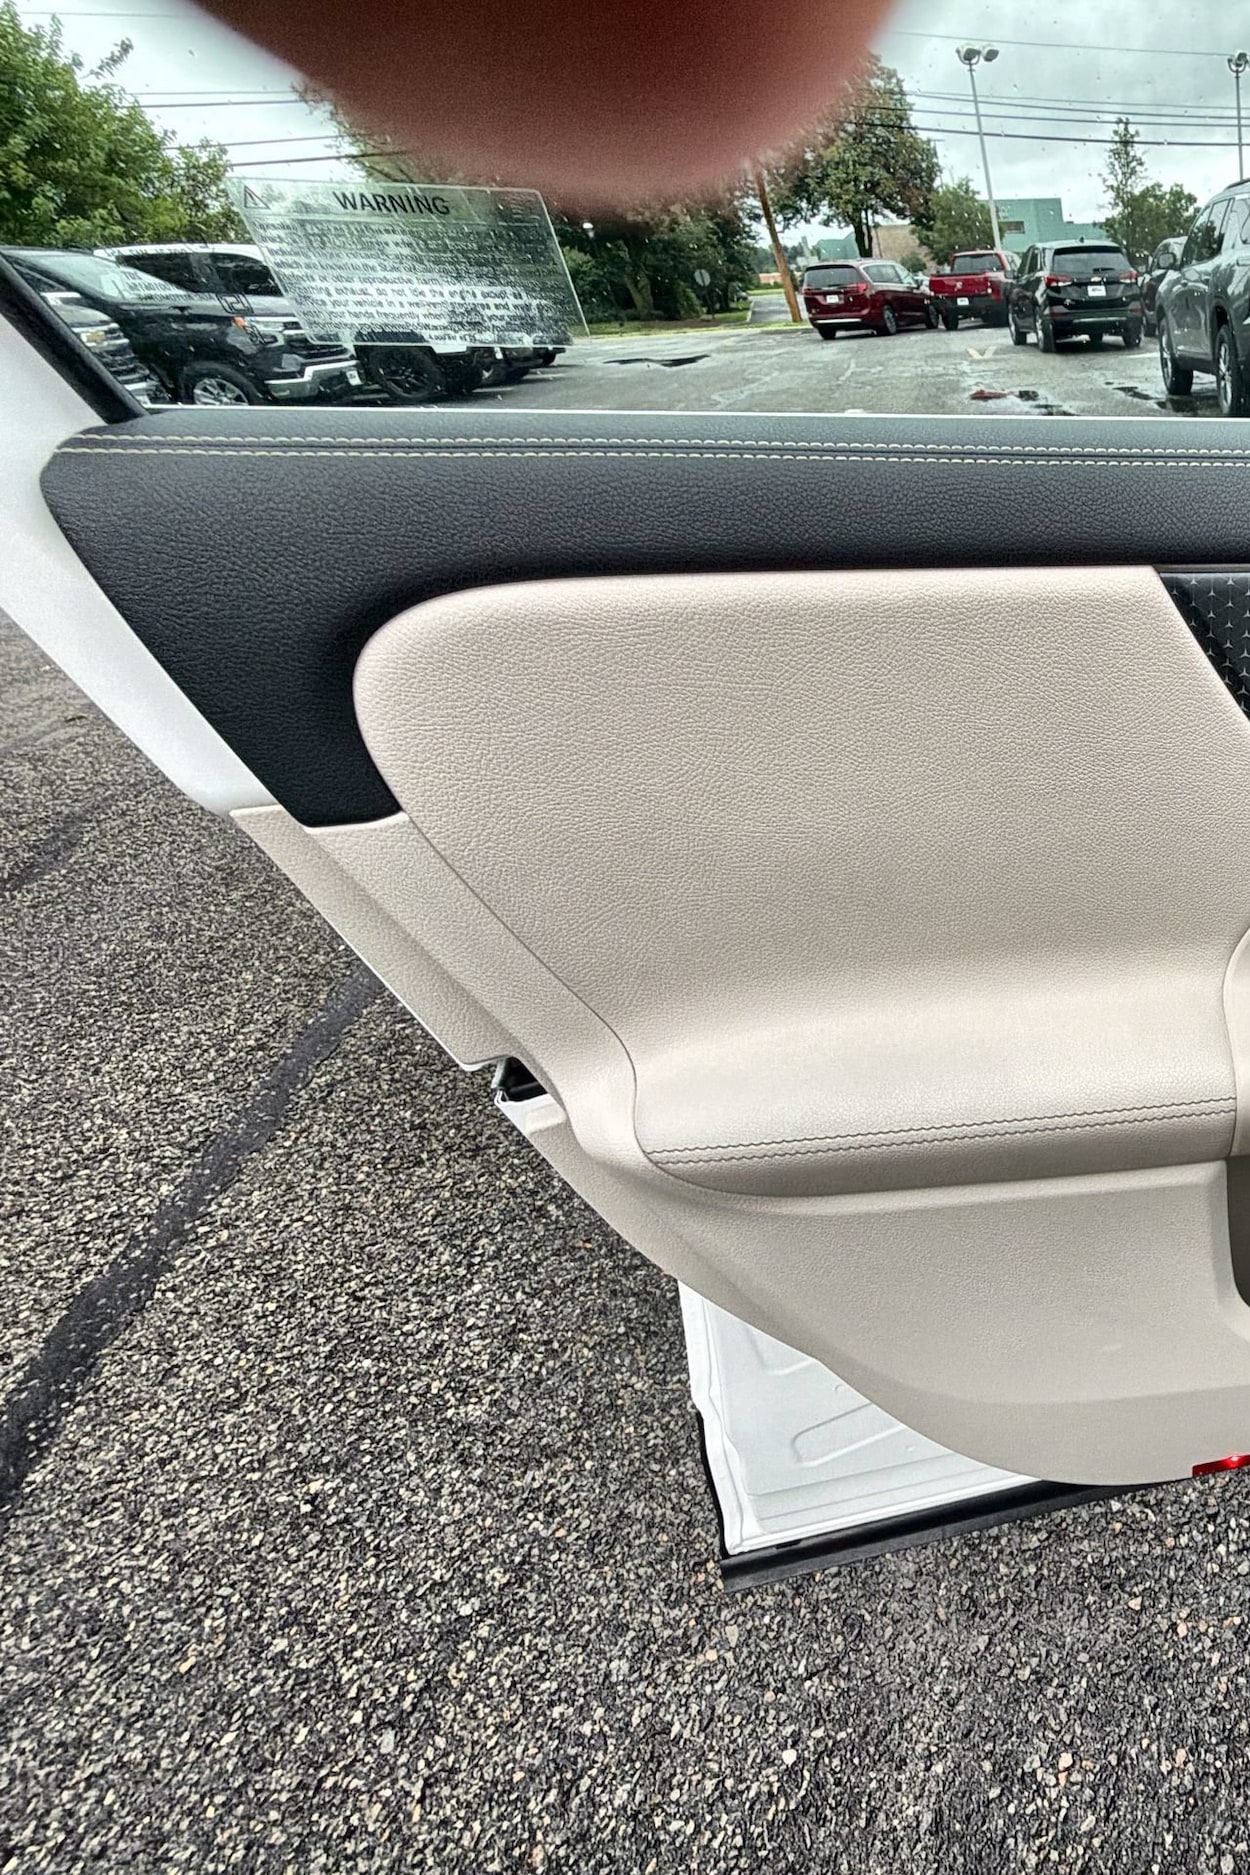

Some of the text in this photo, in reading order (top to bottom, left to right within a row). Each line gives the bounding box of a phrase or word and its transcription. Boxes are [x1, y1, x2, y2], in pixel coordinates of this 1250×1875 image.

[332, 191, 450, 215] WARNING
[272, 260, 302, 269] which
[318, 262, 351, 270] known
[360, 262, 378, 271] the
[377, 263, 404, 272] State
[358, 276, 415, 285] reproductive
[333, 286, 372, 296] exhaust,
[375, 288, 388, 296] do
[390, 288, 407, 296] not
[409, 287, 426, 297] idle
[427, 288, 444, 297] the
[447, 288, 478, 300] engine
[479, 290, 510, 300] except
[328, 298, 351, 308] your
[350, 297, 384, 307] vehicle
[492, 301, 509, 310] and
[325, 310, 348, 319] your
[346, 308, 374, 318] hands
[375, 308, 420, 320] frequently
[421, 310, 445, 319] when
